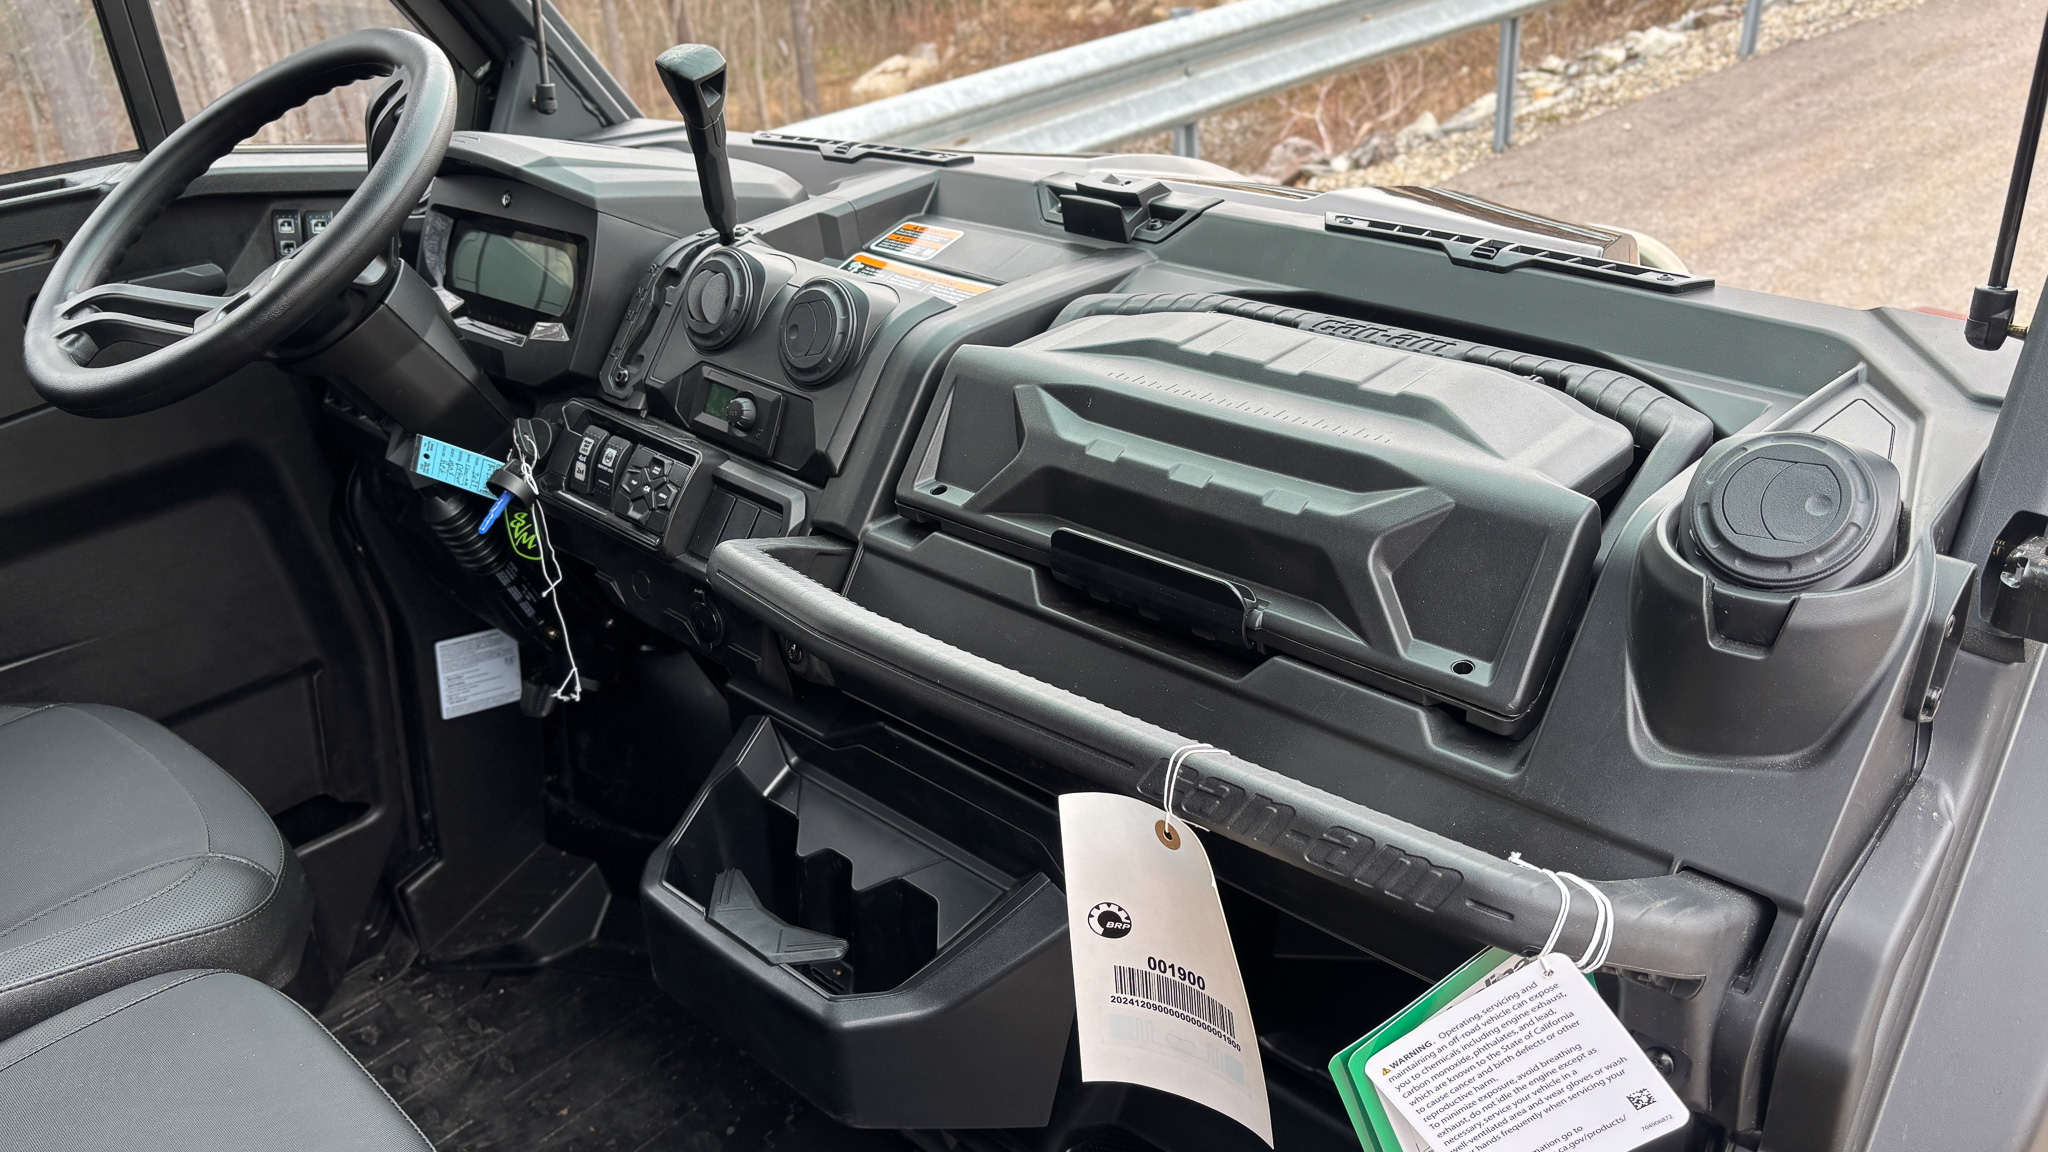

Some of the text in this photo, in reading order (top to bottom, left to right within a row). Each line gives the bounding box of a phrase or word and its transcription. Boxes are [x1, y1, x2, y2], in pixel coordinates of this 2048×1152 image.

[576, 467, 584, 476] 2x4
[1106, 921, 1130, 930] BRP
[1147, 956, 1206, 991] 001900
[1438, 1013, 1483, 1039] Operating,
[1481, 991, 1520, 1015] servicing
[1521, 980, 1538, 994] and
[1388, 983, 1559, 1083] maintaining an off-road vehicle can expose
[1394, 992, 1567, 1092] you to chemicals including engine exhaust,
[1402, 1008, 1557, 1098] carbon monoxide, phthalates, and lead,
[1408, 1011, 1574, 1106] which are known to the State of California
[1415, 1020, 1580, 1114] to cause cancer and birth defects or other
[1423, 1077, 1498, 1122] reproductive harm.
[1436, 1047, 1597, 1138] exhaust, do not idle the engine except as
[1440, 1100, 1477, 1124] minimize
[1477, 1079, 1518, 1102] exposure,
[1516, 1063, 1540, 1080] avoid
[1538, 1043, 1582, 1068] breathing
[1443, 1121, 1484, 1146] necessary,
[1483, 1104, 1512, 1123] service
[1511, 1093, 1531, 1108] your
[1531, 1078, 1561, 1096] vehicle
[1452, 1117, 1508, 1151] well-ventilated
[1508, 1108, 1527, 1121] area
[1527, 1097, 1544, 1111] and
[1543, 1087, 1565, 1101] wear
[1565, 1073, 1594, 1091] gloves
[1593, 1067, 1603, 1076] or
[1604, 1056, 1627, 1070] wash
[1474, 1134, 1501, 1151] hands
[1500, 1111, 1542, 1137] frequently
[1542, 1098, 1567, 1113] when
[1567, 1079, 1606, 1101] servicing
[1605, 1068, 1625, 1083] your
[1558, 1114, 1626, 1152] ca.gov/products/
[1560, 1131, 1573, 1141] go
